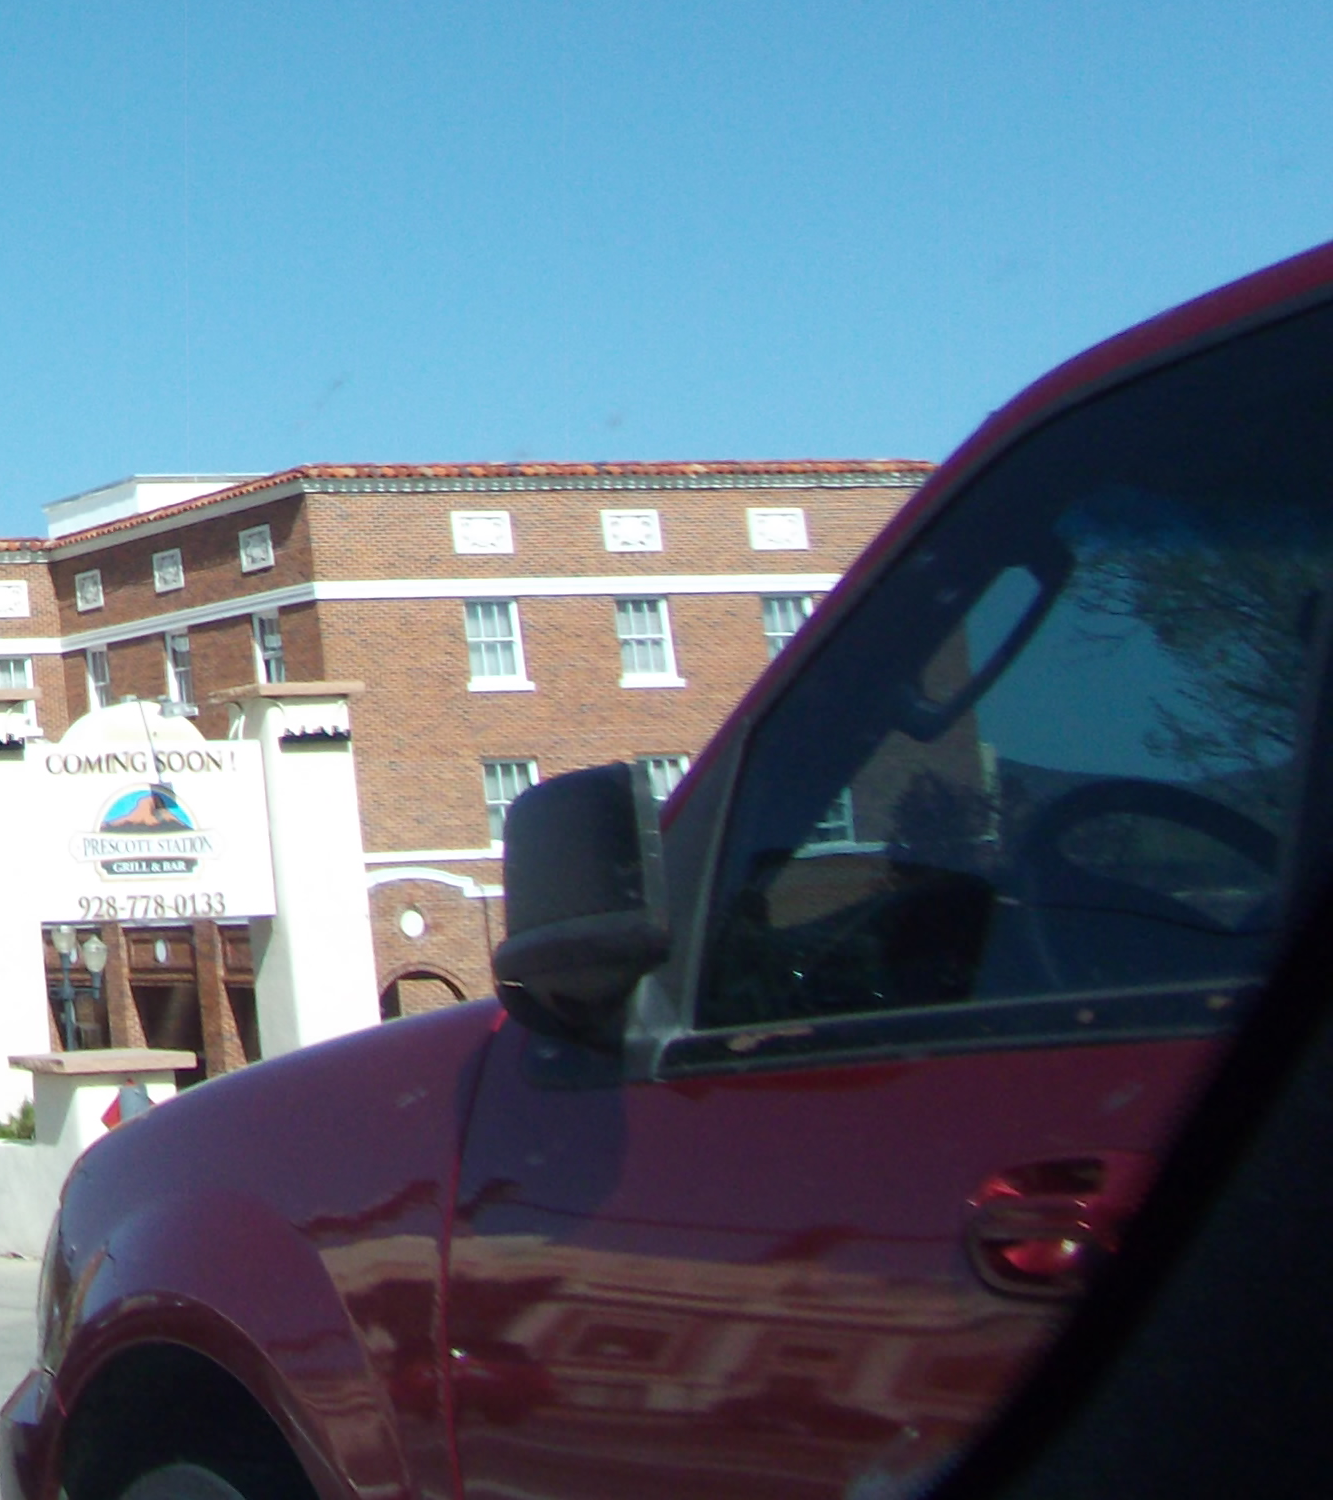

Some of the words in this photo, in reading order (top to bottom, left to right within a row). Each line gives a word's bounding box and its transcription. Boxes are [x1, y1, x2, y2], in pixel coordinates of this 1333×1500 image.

[45, 752, 147, 775] COMING
[157, 750, 223, 773] SOON
[83, 837, 152, 857] PRESCOTT
[157, 835, 214, 854] STATION
[112, 861, 150, 873] GRILL
[151, 861, 161, 873] &
[163, 860, 187, 872] BAR
[78, 892, 226, 919] 928-778-0133
